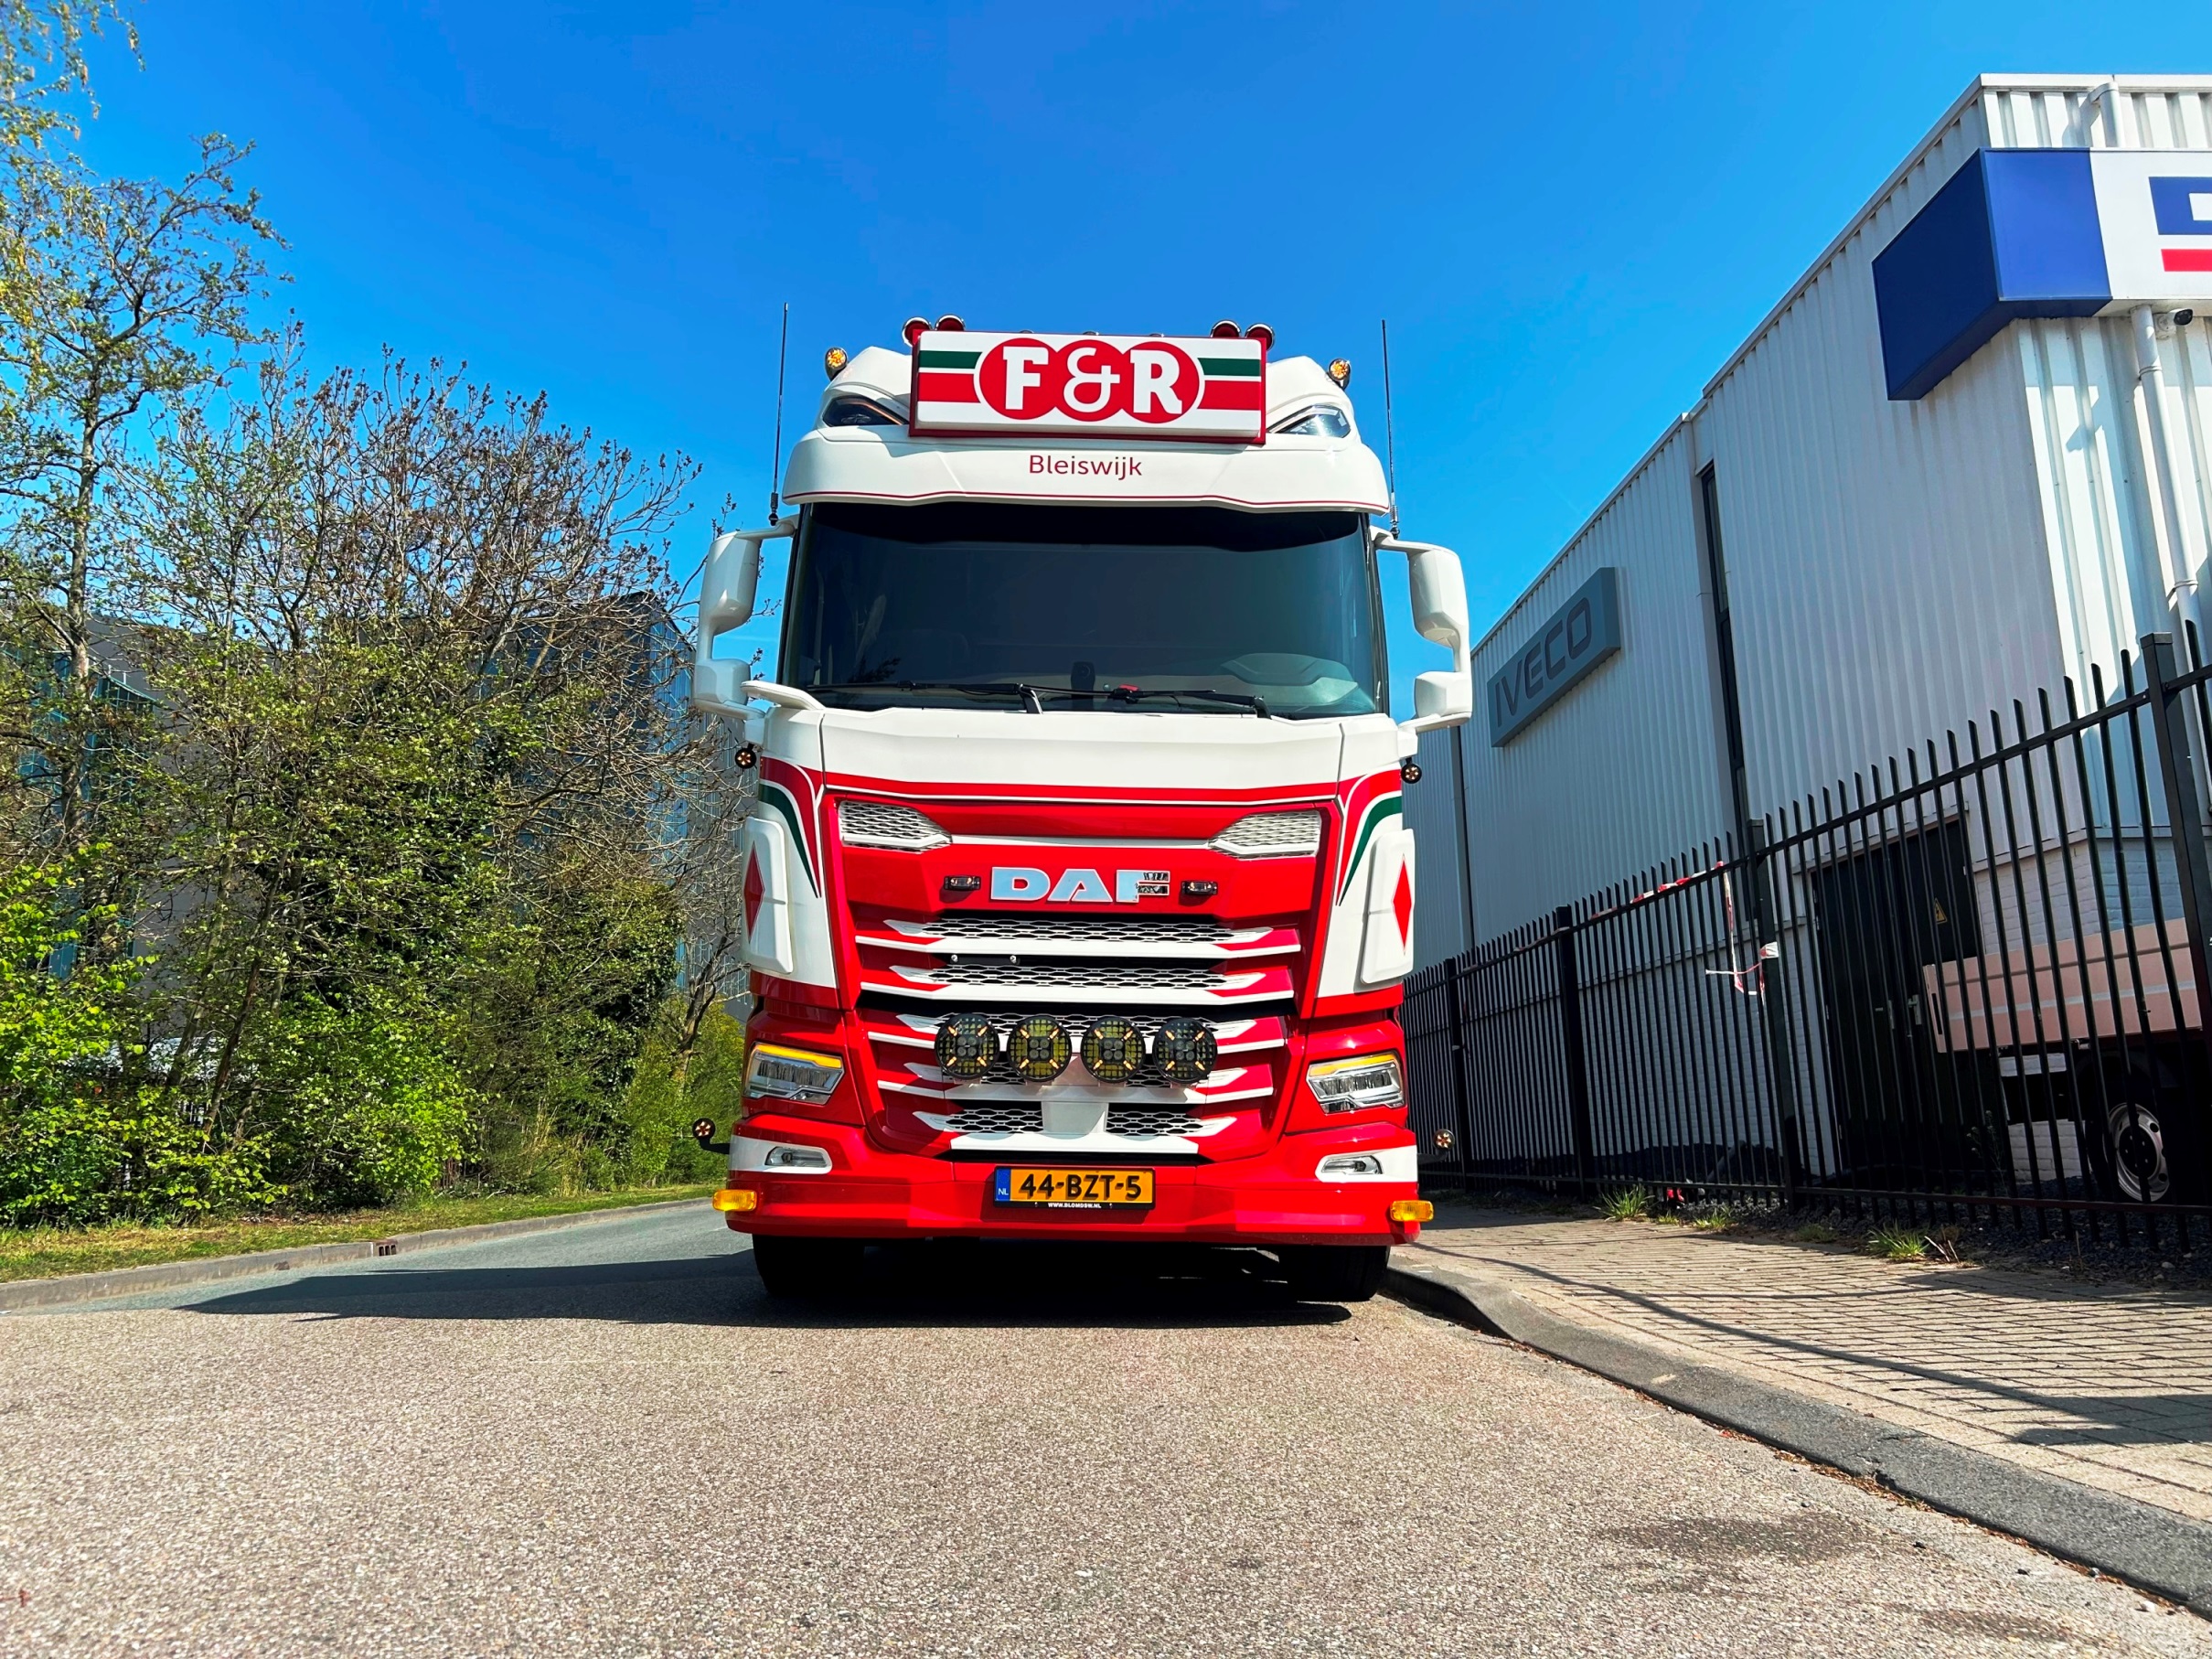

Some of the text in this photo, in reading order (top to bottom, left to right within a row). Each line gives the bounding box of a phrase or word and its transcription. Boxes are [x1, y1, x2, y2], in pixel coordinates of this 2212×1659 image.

[1003, 347, 1182, 415] F&R
[1029, 455, 1142, 481] Bleiswijk
[1494, 597, 1592, 728] IVECO
[990, 867, 1170, 904] DAF
[998, 1173, 1142, 1201] NL 44-BZT-5
